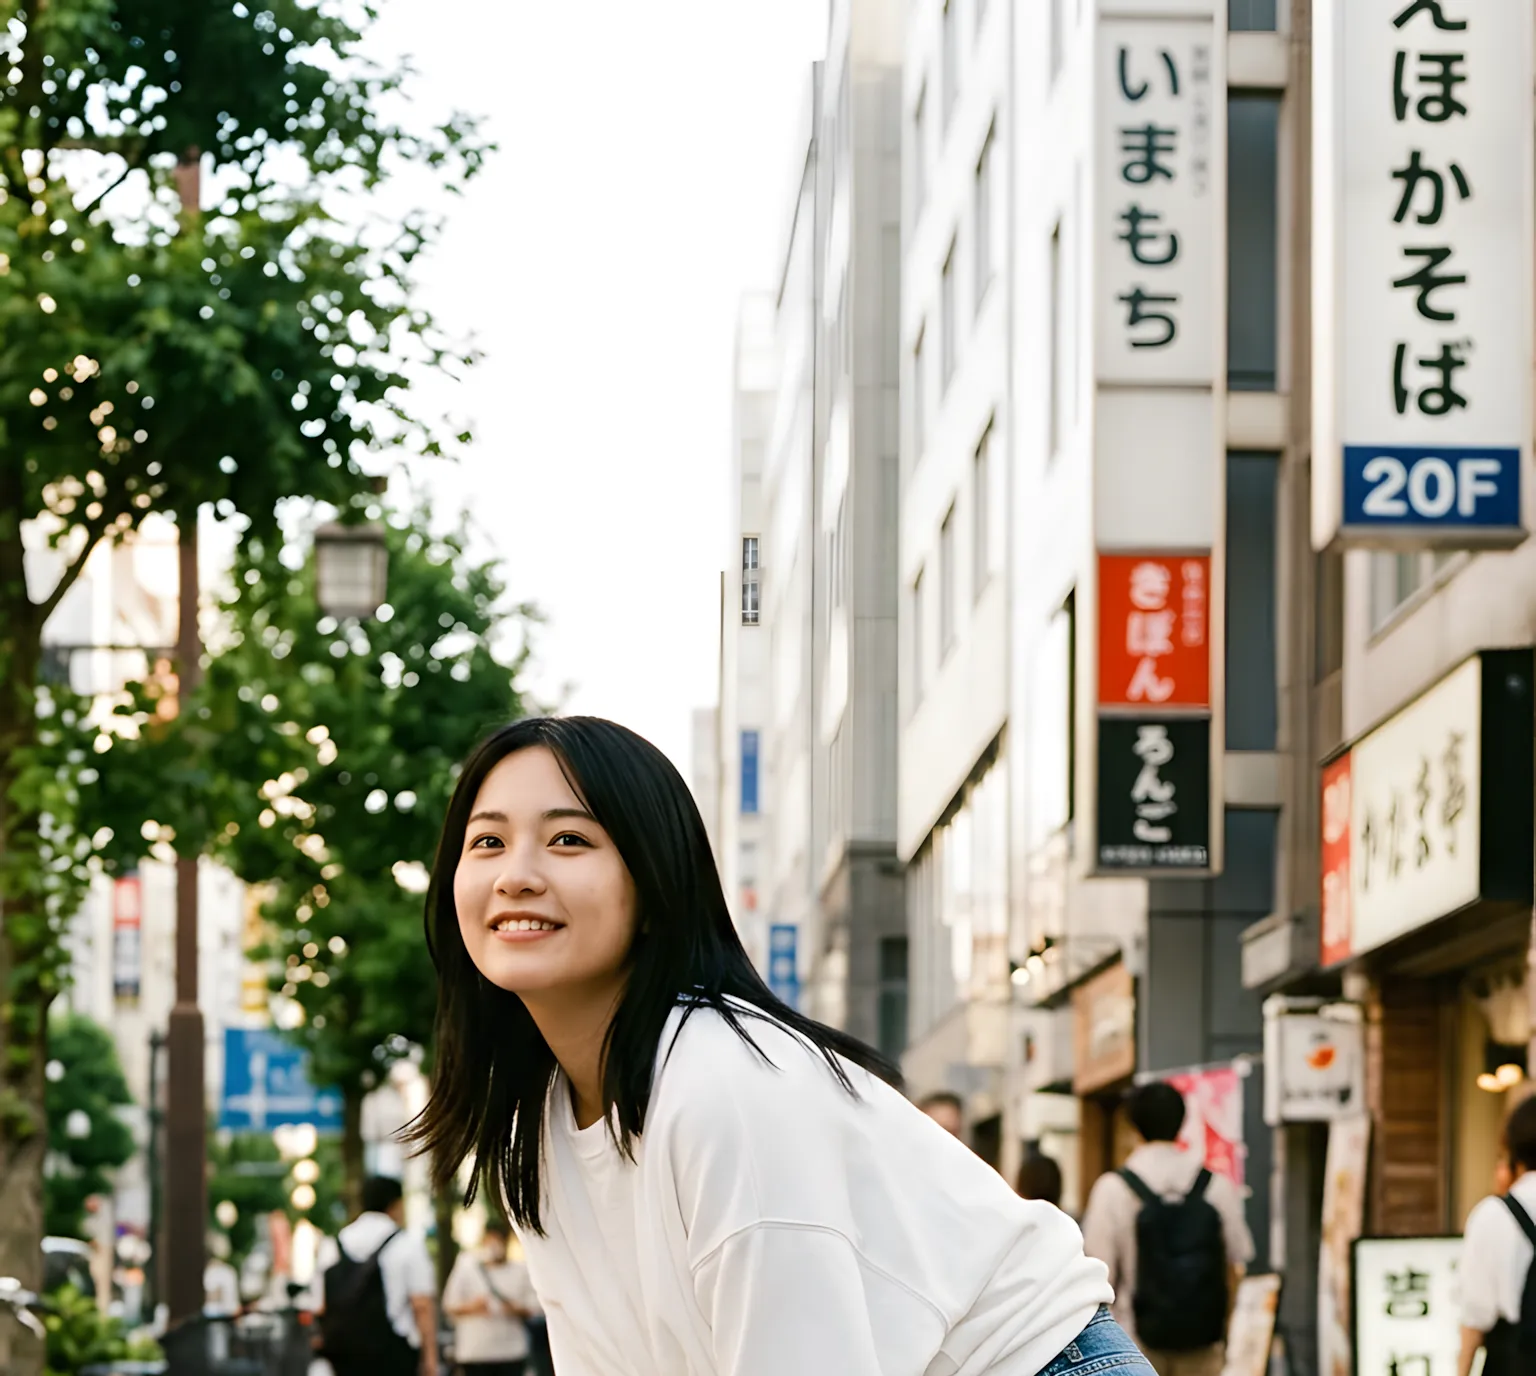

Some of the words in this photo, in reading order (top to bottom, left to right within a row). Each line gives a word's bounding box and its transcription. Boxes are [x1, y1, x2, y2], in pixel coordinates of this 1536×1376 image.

[1118, 47, 1179, 349] いまもち
[1363, 457, 1501, 517] 20F
